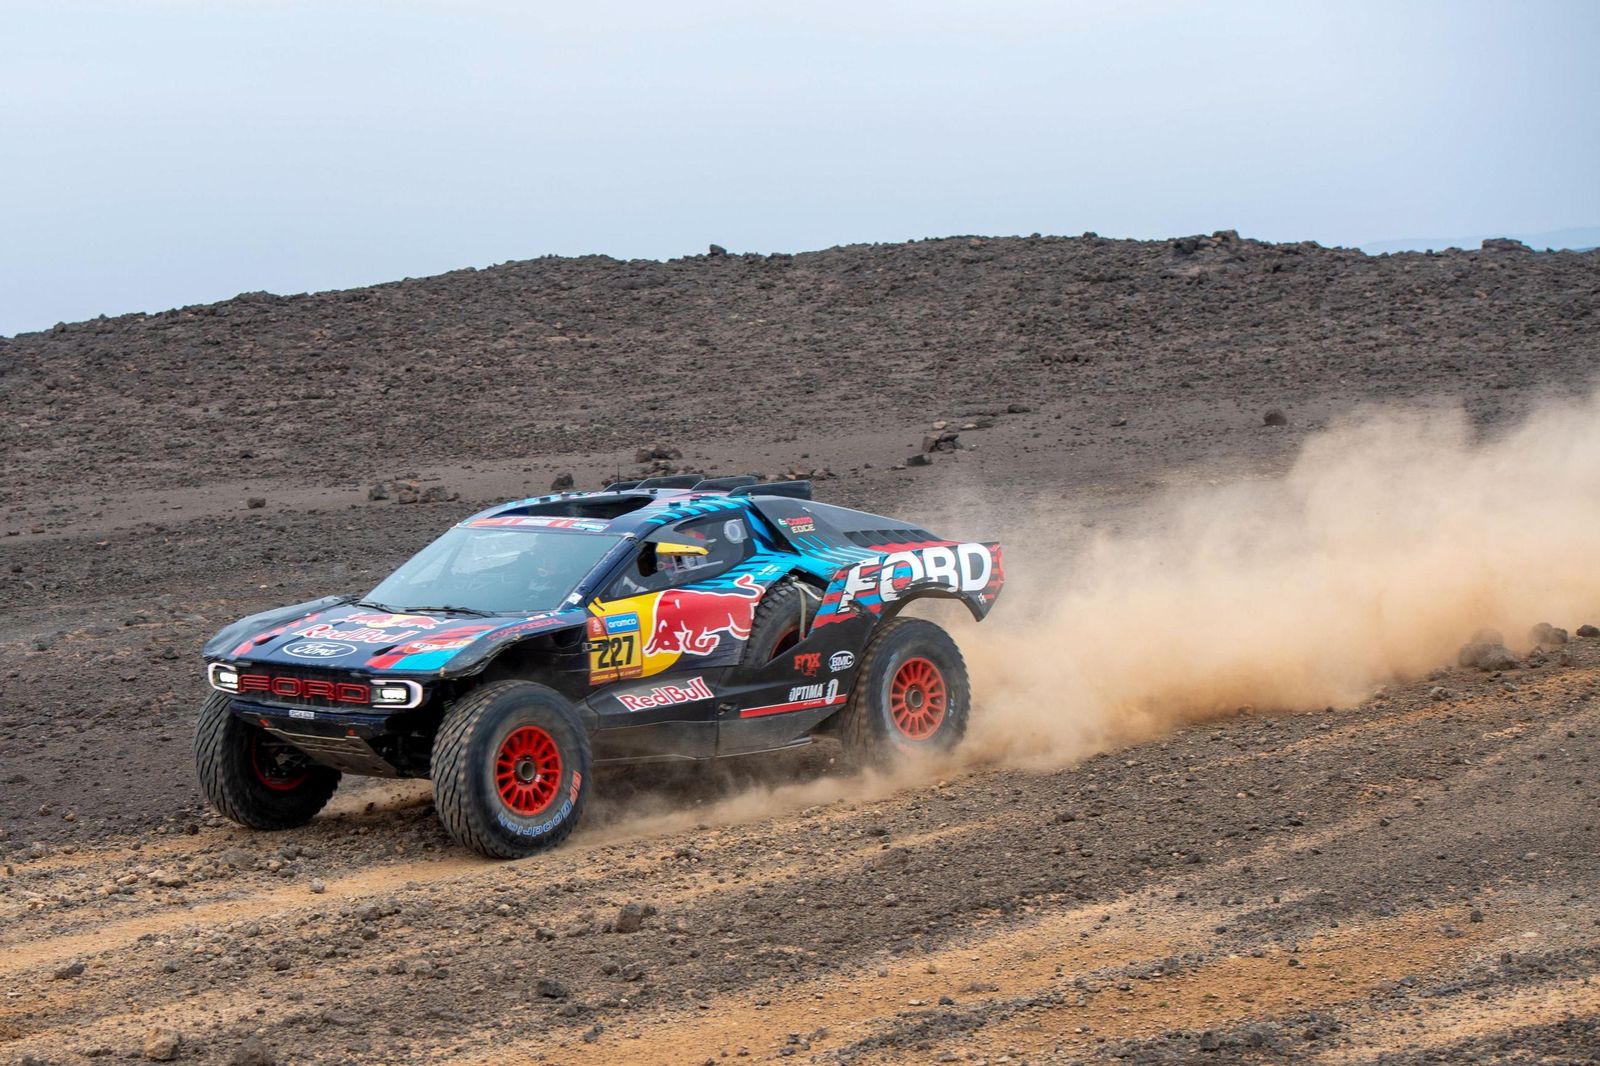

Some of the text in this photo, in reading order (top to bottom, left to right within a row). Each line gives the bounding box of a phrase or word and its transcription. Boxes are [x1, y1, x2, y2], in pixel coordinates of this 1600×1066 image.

[791, 523, 816, 534] EDGE
[836, 542, 993, 614] FORD
[608, 618, 637, 628] aramco
[293, 643, 345, 656] Ford
[597, 635, 634, 669] 227
[794, 652, 822, 674] FOX
[831, 655, 853, 667] BMC
[239, 674, 370, 704] FORD
[788, 683, 824, 702] OPTIMA
